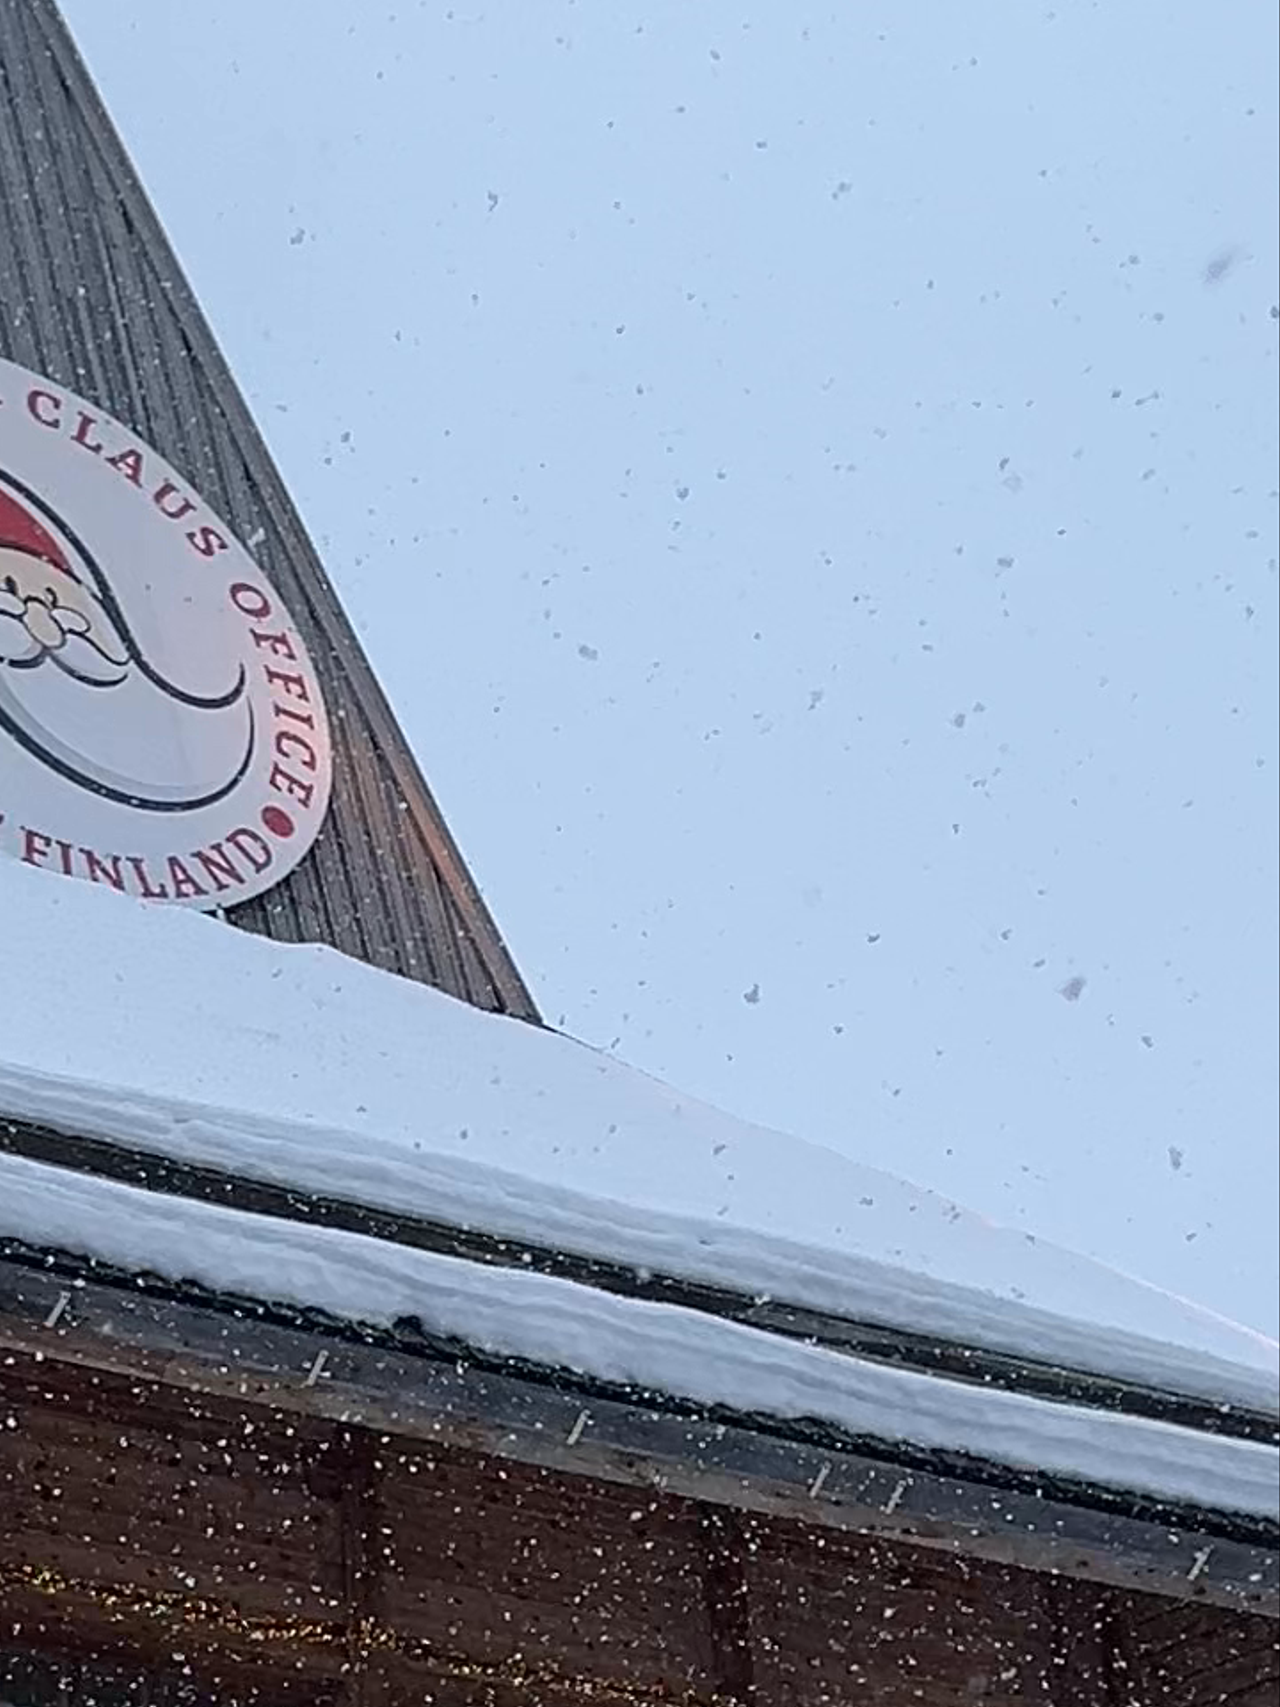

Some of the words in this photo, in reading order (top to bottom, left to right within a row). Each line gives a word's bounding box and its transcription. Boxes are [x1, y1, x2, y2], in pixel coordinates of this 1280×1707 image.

[26, 389, 230, 559] CLAUS
[229, 581, 319, 809] OFFICE
[19, 825, 273, 898] FINLAND
